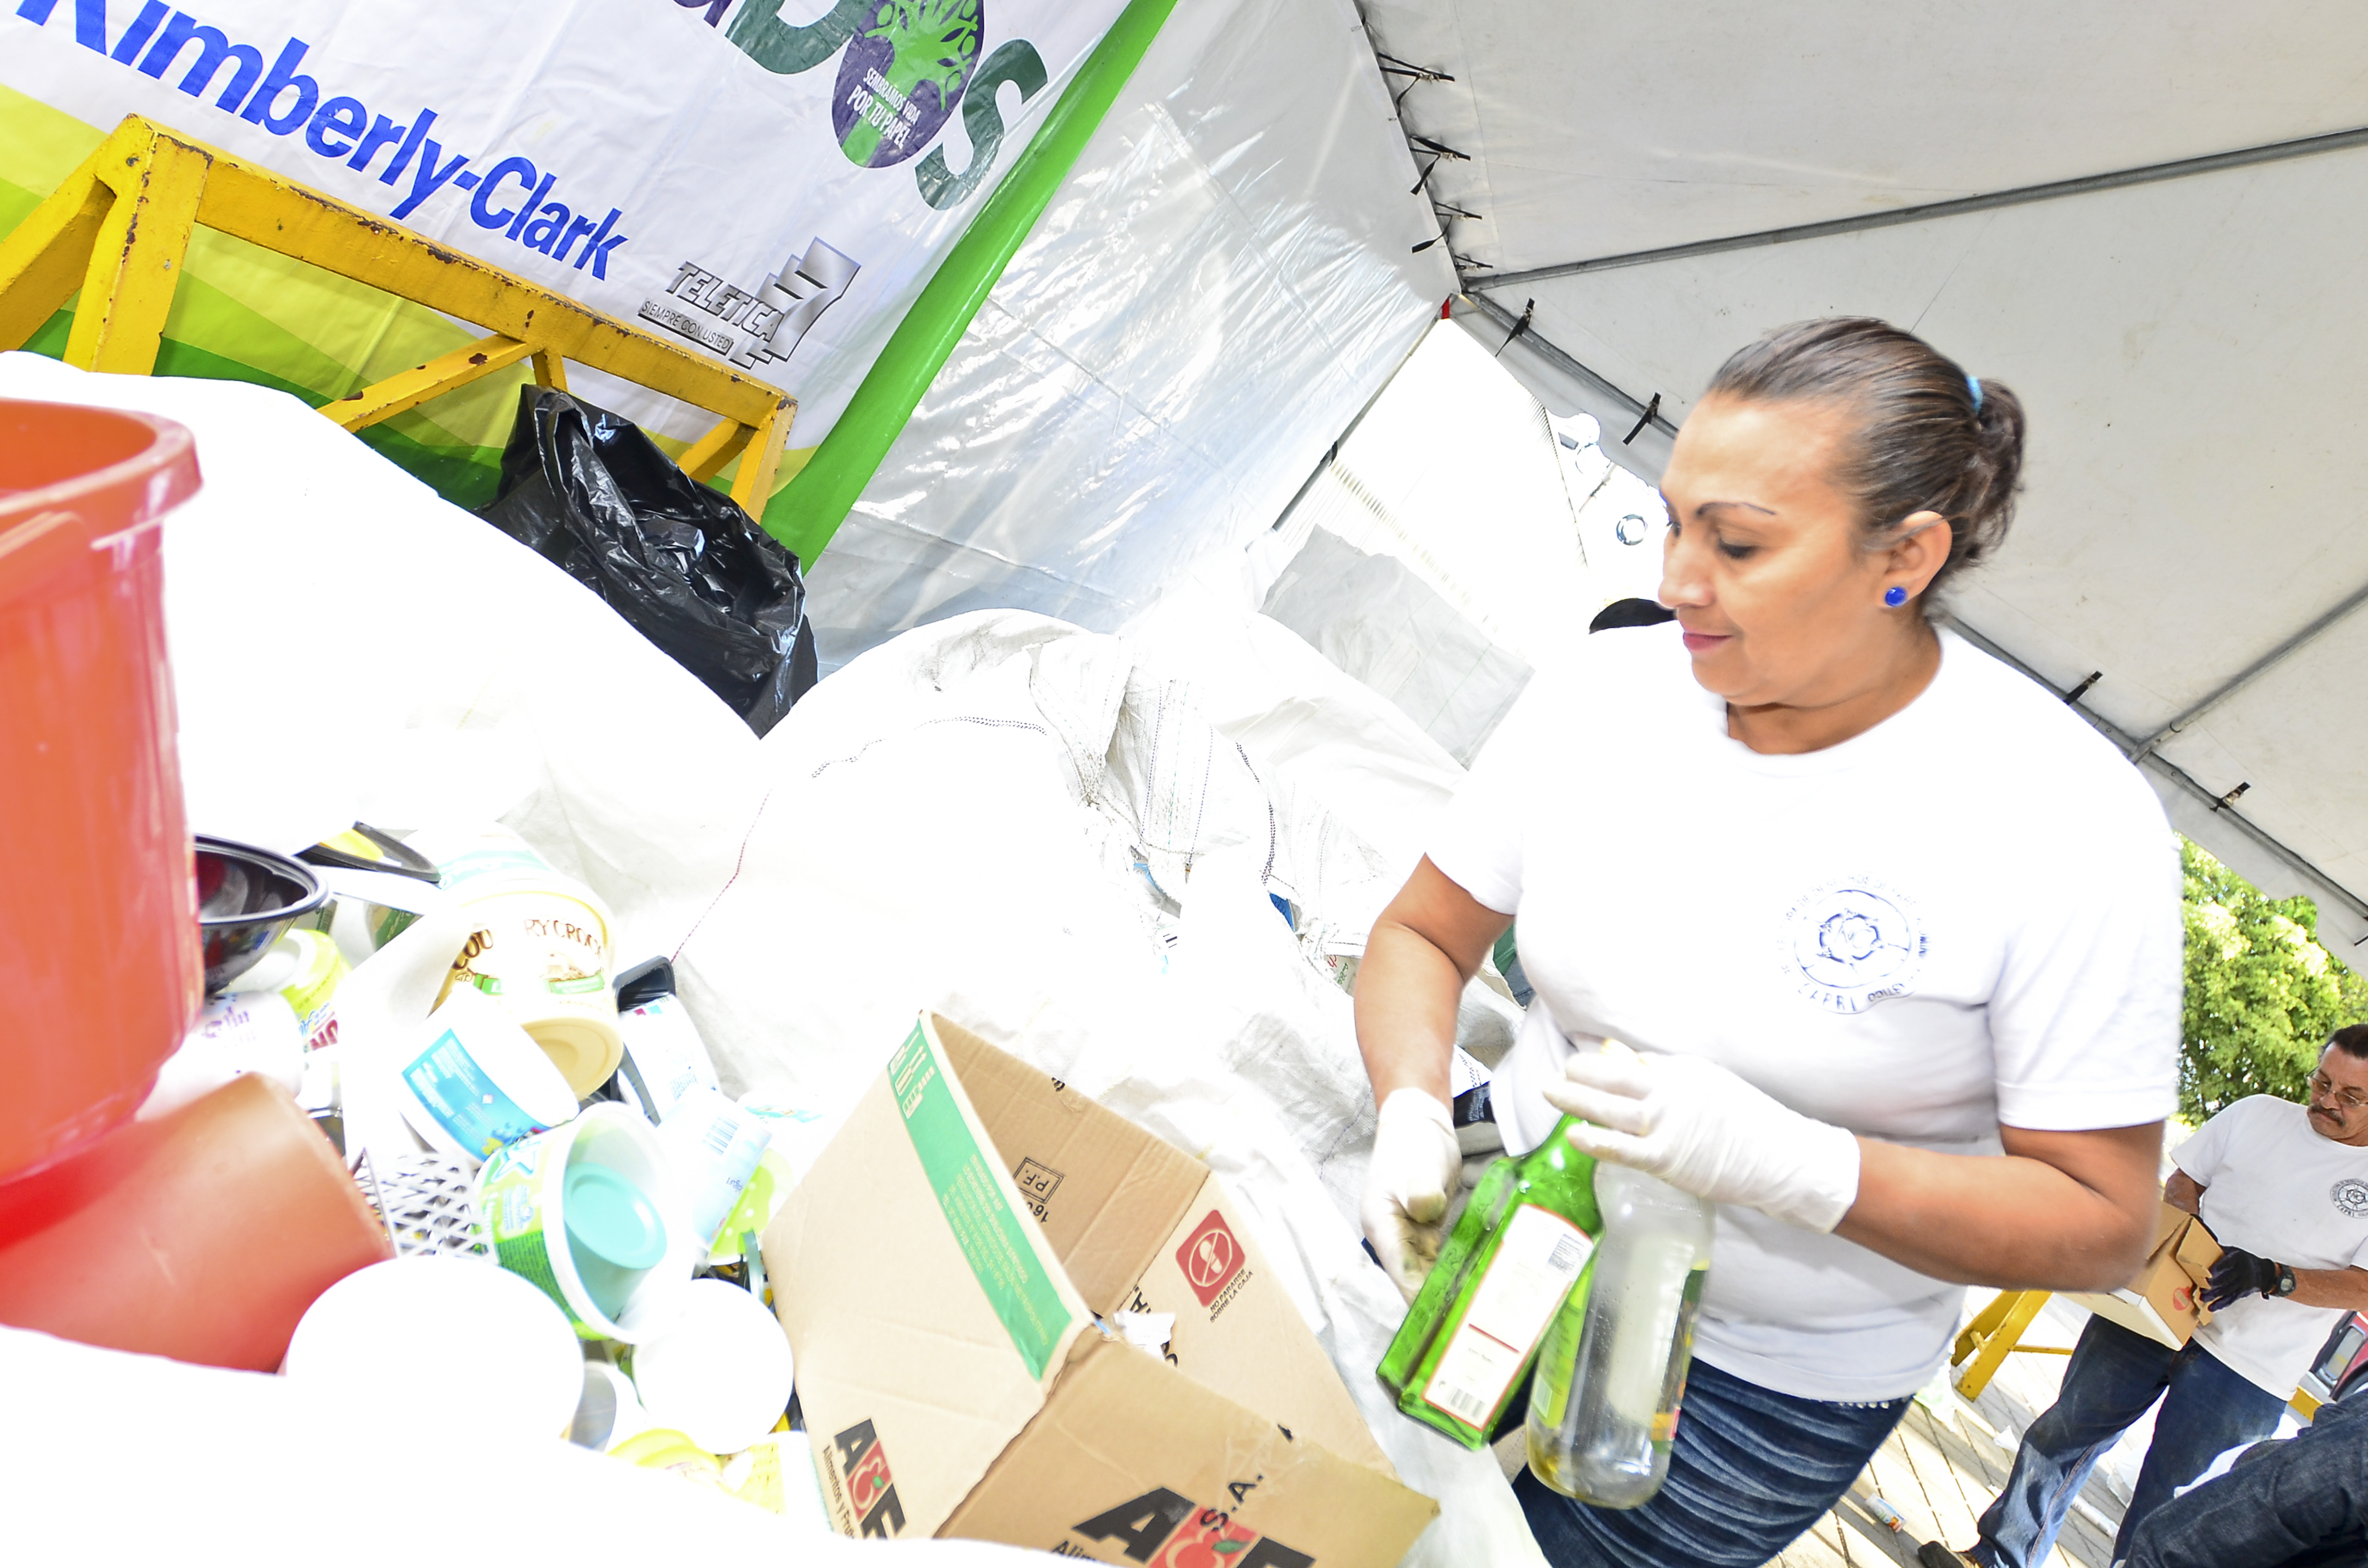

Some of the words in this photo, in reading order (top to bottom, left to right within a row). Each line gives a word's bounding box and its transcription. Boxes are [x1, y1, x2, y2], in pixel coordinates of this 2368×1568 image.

[846, 84, 873, 117] POR
[868, 101, 887, 127] TU
[879, 112, 910, 149] PAPEL
[863, 67, 906, 111] SEMBRAMOS
[902, 100, 921, 125] VIDA
[642, 300, 680, 326] SIEMPRE
[681, 319, 702, 337] CON
[703, 328, 730, 350] USTED
[665, 261, 785, 343] TELETICA
[1210, 1300, 1220, 1313] NO
[1219, 1268, 1246, 1302] PARARSE
[1210, 1298, 1230, 1323] SOBRE
[1229, 1289, 1239, 1300] LA
[1237, 1271, 1253, 1290] CAJA
[823, 1445, 842, 1504] Alimentos
[836, 1502, 845, 1514] y
[841, 1510, 855, 1539] Frut
[1199, 1474, 1264, 1533] S.A.
